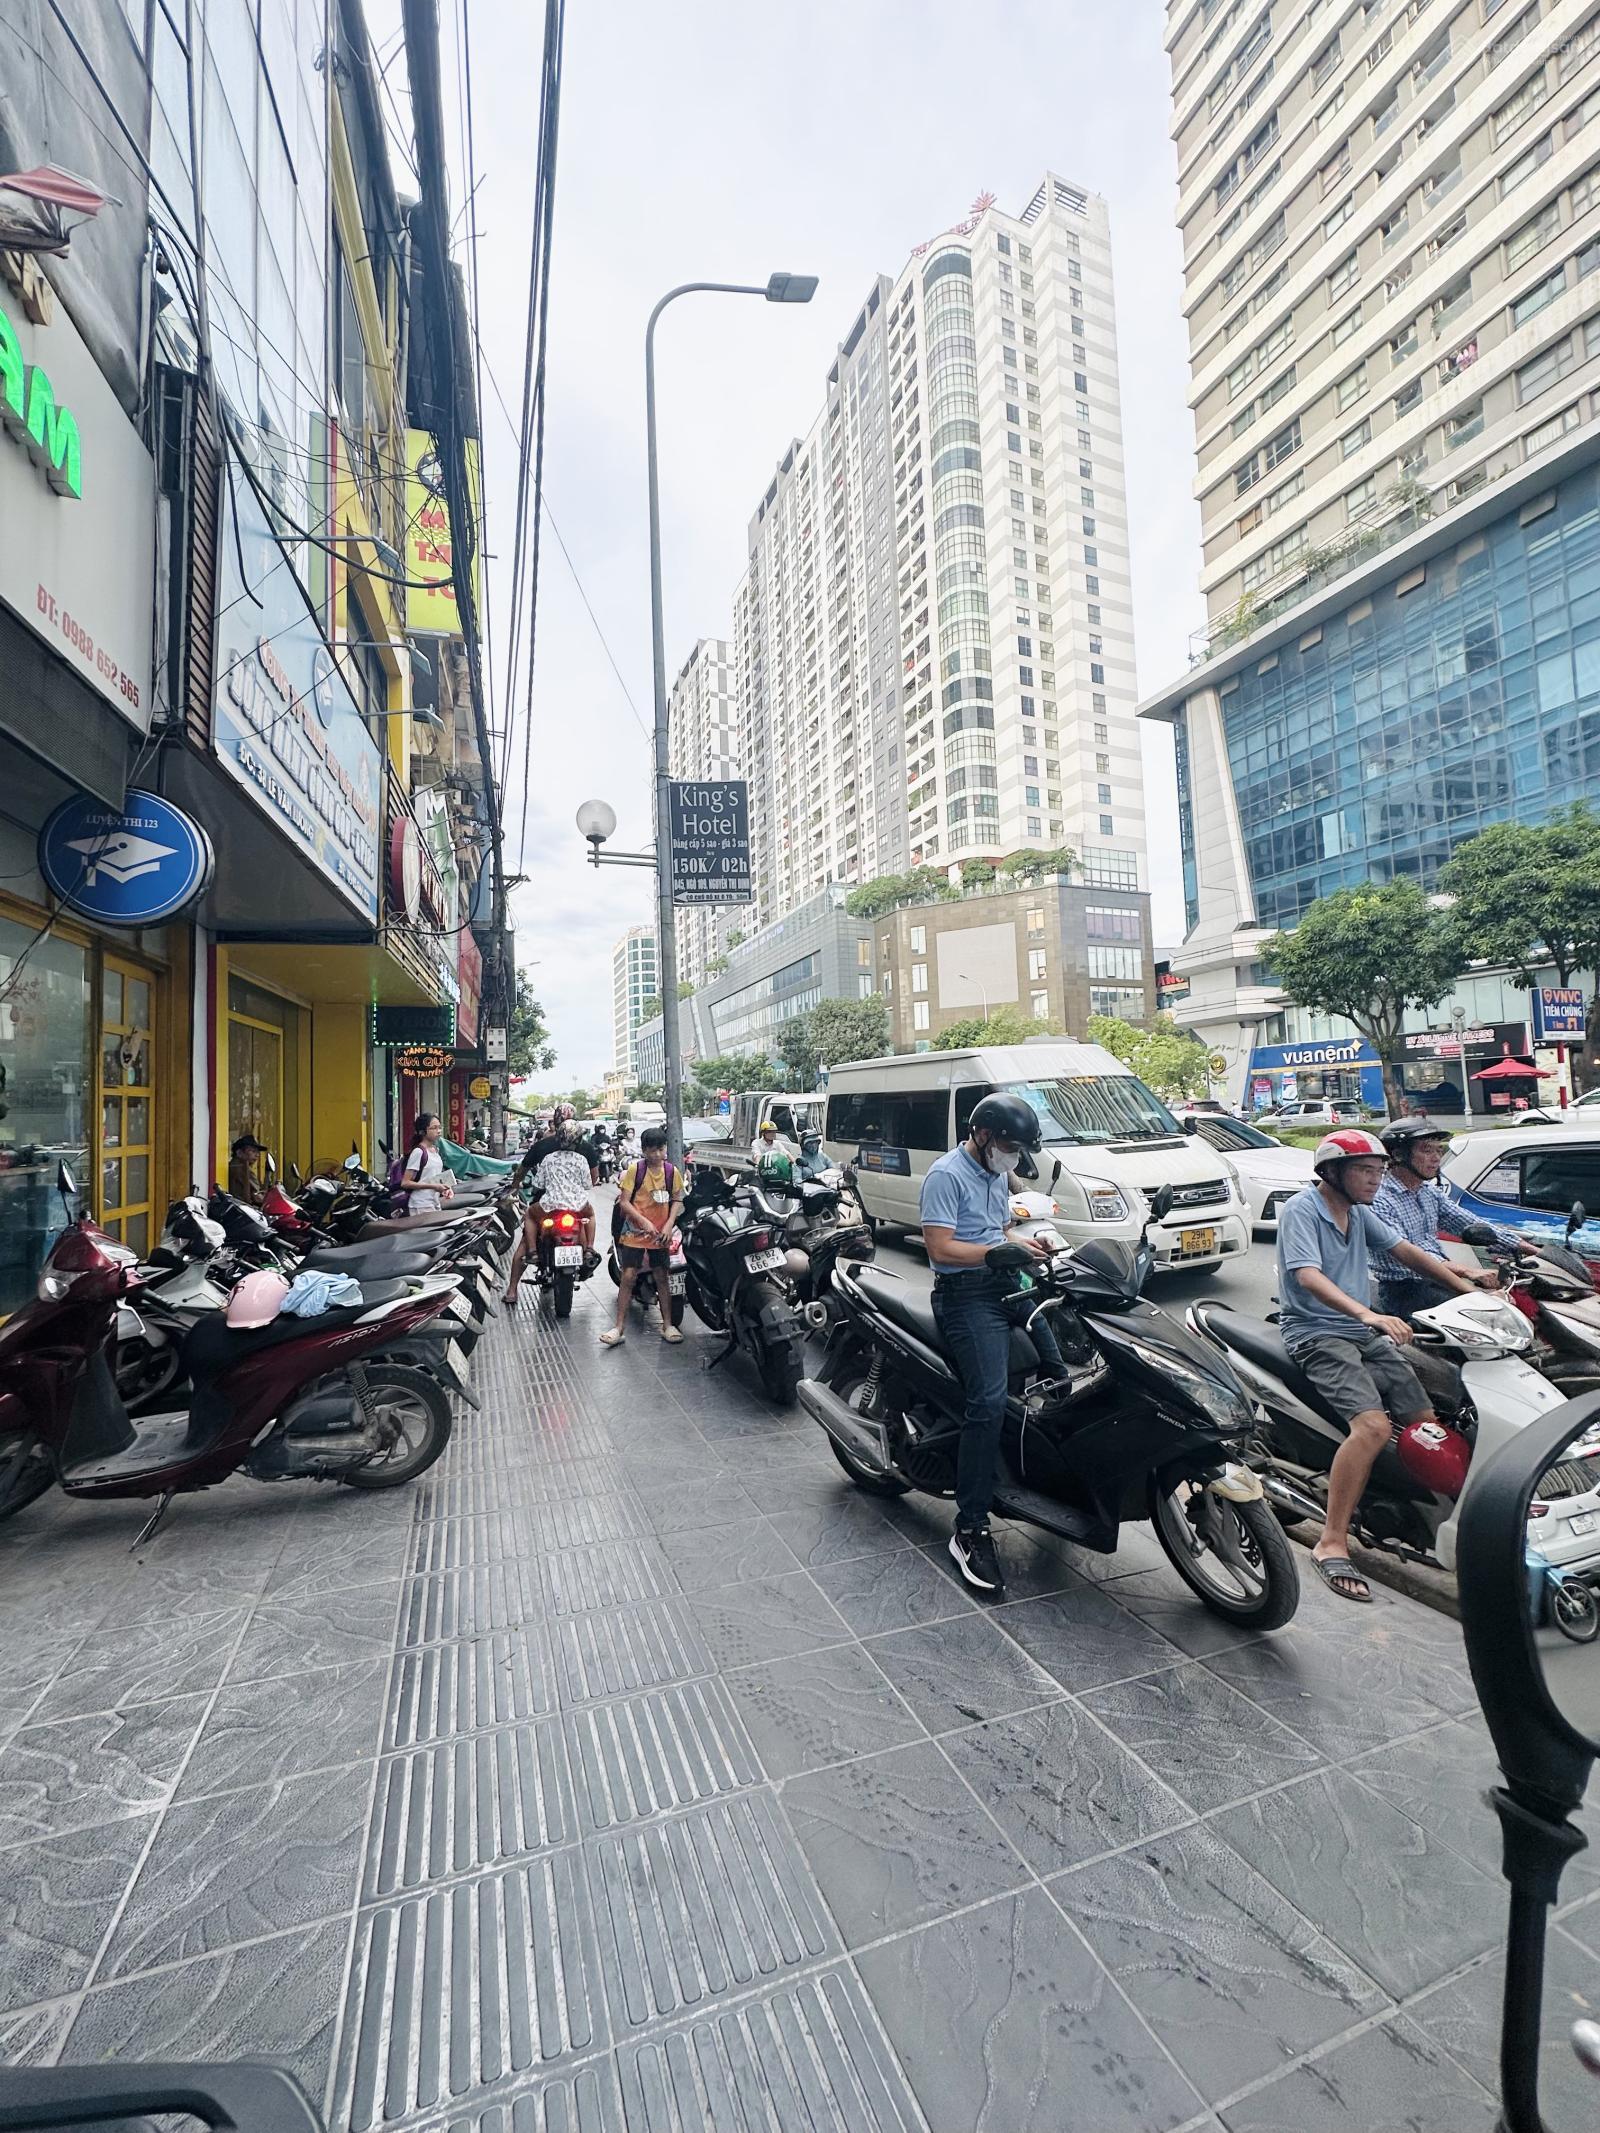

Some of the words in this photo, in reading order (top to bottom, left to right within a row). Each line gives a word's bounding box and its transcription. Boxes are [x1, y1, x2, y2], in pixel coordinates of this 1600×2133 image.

[37, 584, 59, 627] ĐT:
[61, 610, 95, 663] 0988
[97, 646, 118, 688] 652
[120, 670, 140, 709] 565
[680, 785, 739, 813] King's
[122, 816, 143, 828] THI
[144, 818, 159, 829] 123
[682, 813, 737, 835] Hotel
[689, 838, 700, 850] cấp
[700, 838, 706, 848] 5
[706, 840, 717, 848] sao
[731, 838, 737, 848] 3
[737, 840, 748, 848] sao
[673, 857, 717, 874] 150K/
[721, 857, 748, 873] 02h
[1553, 989, 1582, 1004] VNVC
[1544, 1004, 1560, 1017] TIÊM
[398, 1057, 420, 1067] KIM
[403, 1068, 416, 1077] GIA
[1191, 1230, 1206, 1240] 29H
[327, 1325, 381, 1349] VISION
[1157, 1412, 1187, 1432] HONDA
